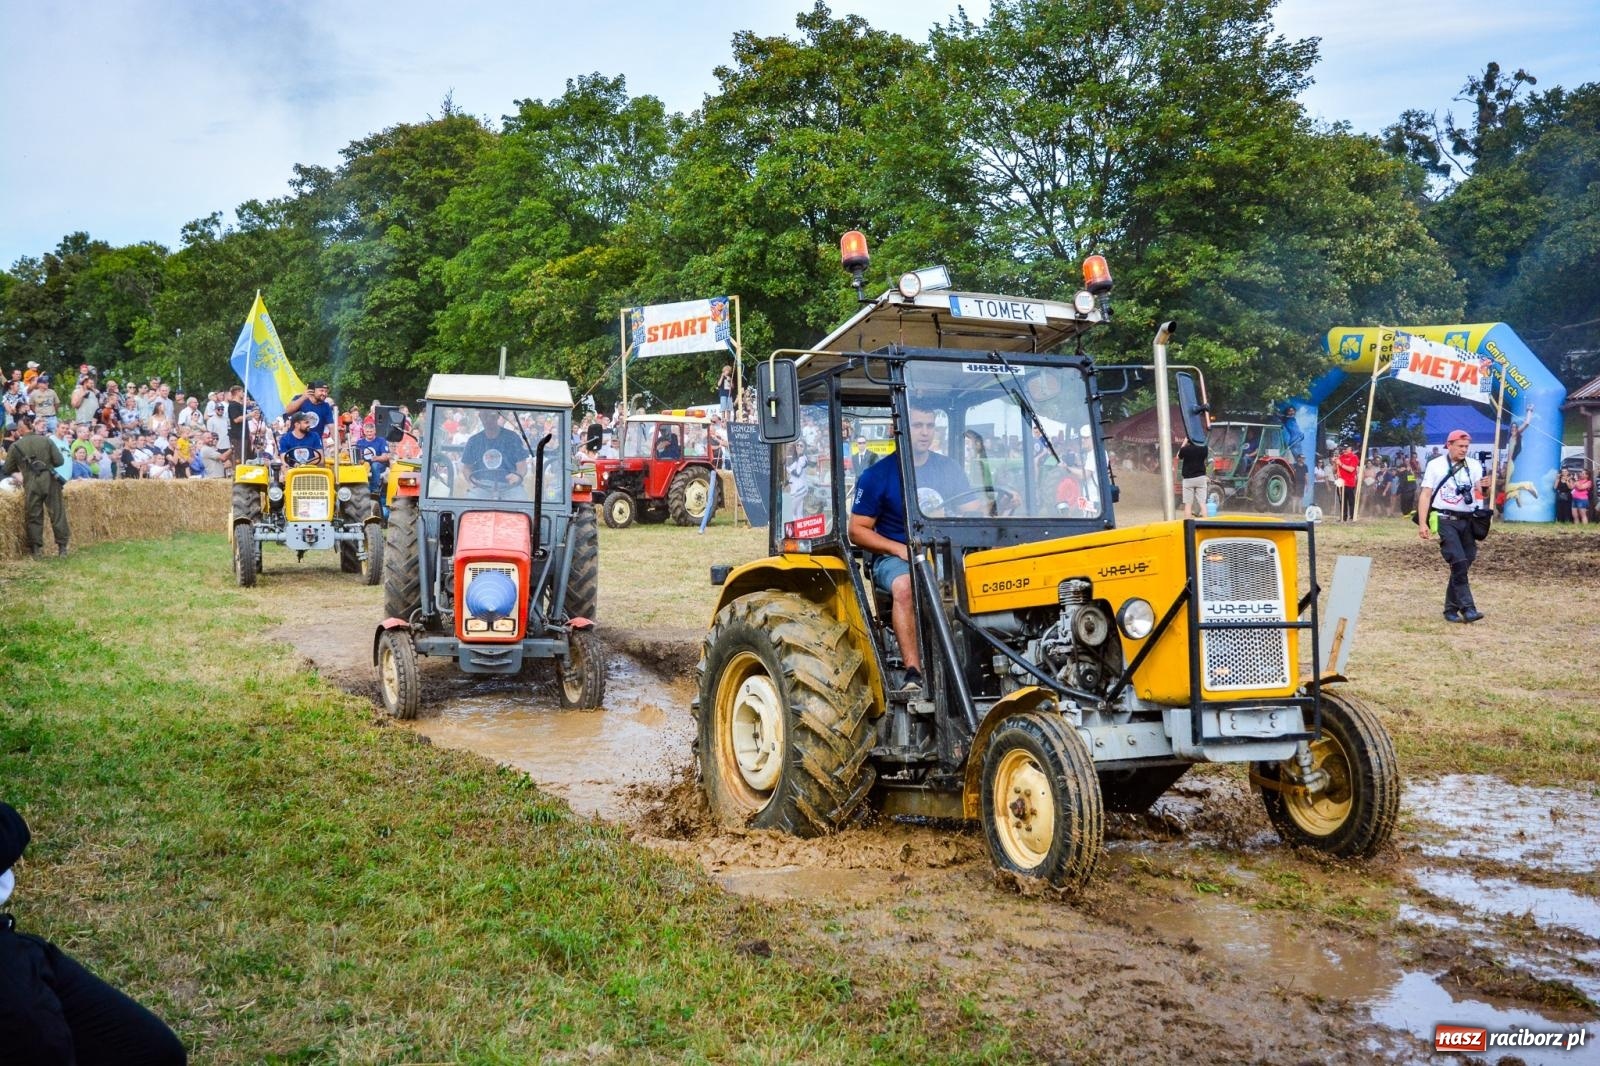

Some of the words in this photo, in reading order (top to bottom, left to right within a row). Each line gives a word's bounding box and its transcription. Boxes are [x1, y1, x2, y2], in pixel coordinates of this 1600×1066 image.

[974, 300, 1034, 321] TOMEK
[647, 316, 711, 343] START
[966, 364, 1021, 374] URSUS
[1409, 352, 1479, 386] META
[1508, 365, 1532, 390] ludzi
[1098, 562, 1149, 578] URSUS
[982, 577, 1031, 593] C-360-3P
[1208, 604, 1278, 615] URSUS
